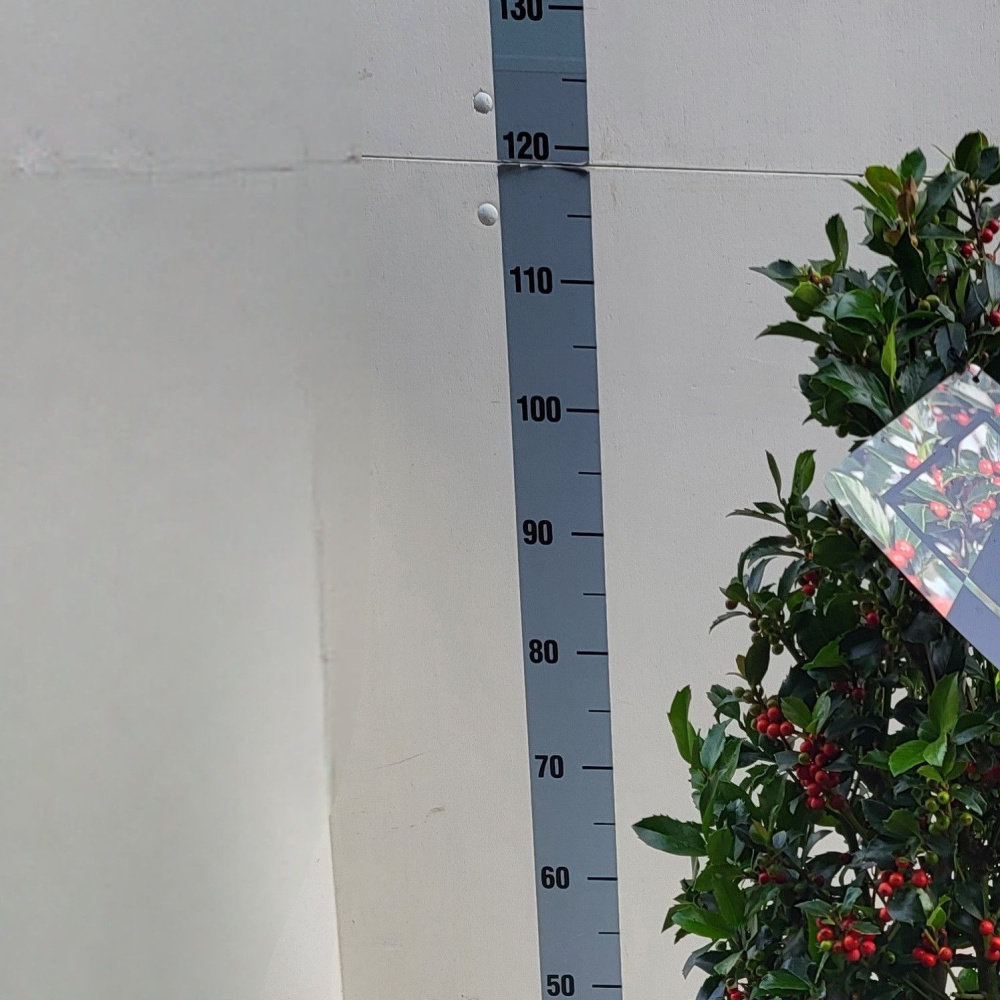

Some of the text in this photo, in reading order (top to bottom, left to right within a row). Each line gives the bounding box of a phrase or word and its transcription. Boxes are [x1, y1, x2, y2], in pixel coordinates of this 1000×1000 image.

[500, 0, 544, 21] 130
[502, 130, 550, 161] 120
[509, 265, 554, 295] 110
[516, 394, 562, 423] 100
[522, 519, 554, 546] 90
[528, 638, 559, 664] 80
[534, 754, 564, 779] 70
[540, 865, 570, 890] 60
[546, 974, 575, 997] 50
